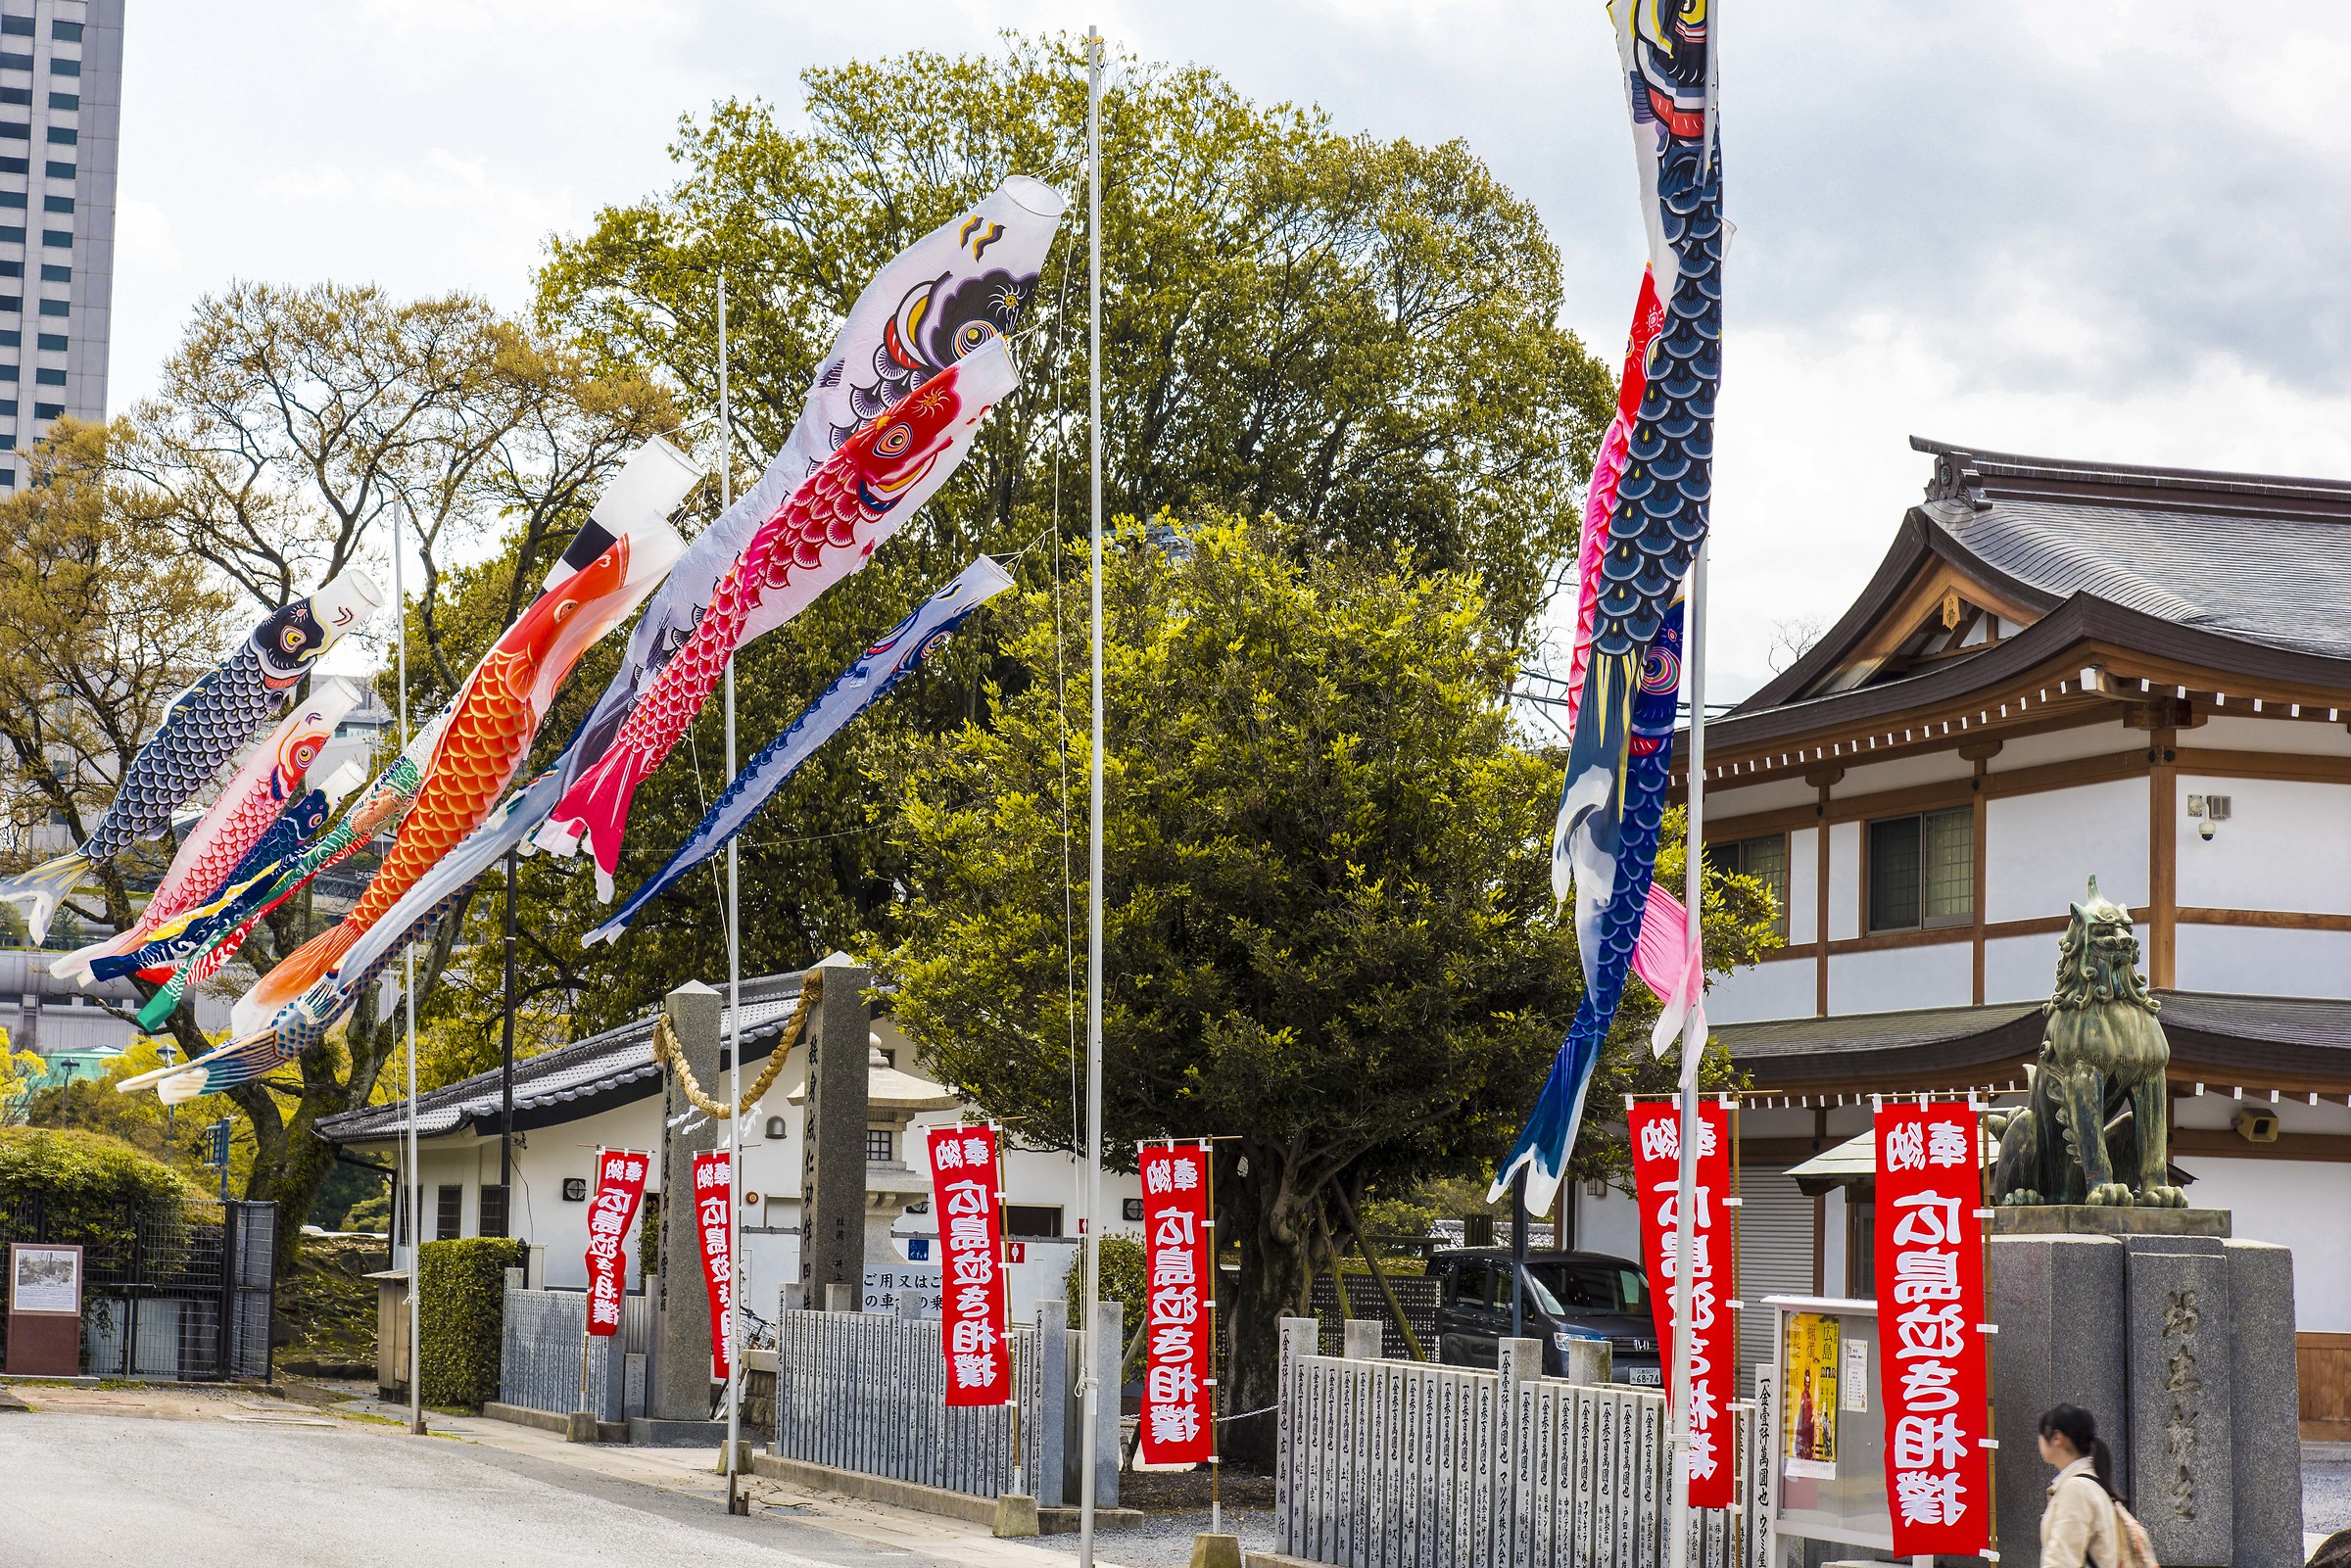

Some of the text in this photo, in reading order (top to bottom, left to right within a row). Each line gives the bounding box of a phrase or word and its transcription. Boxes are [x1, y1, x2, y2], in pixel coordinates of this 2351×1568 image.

[1822, 1325, 1833, 1360] 広島
[1636, 1374, 1659, 1383] 68-74
[1498, 1471, 1508, 1568] マツダ株式会
